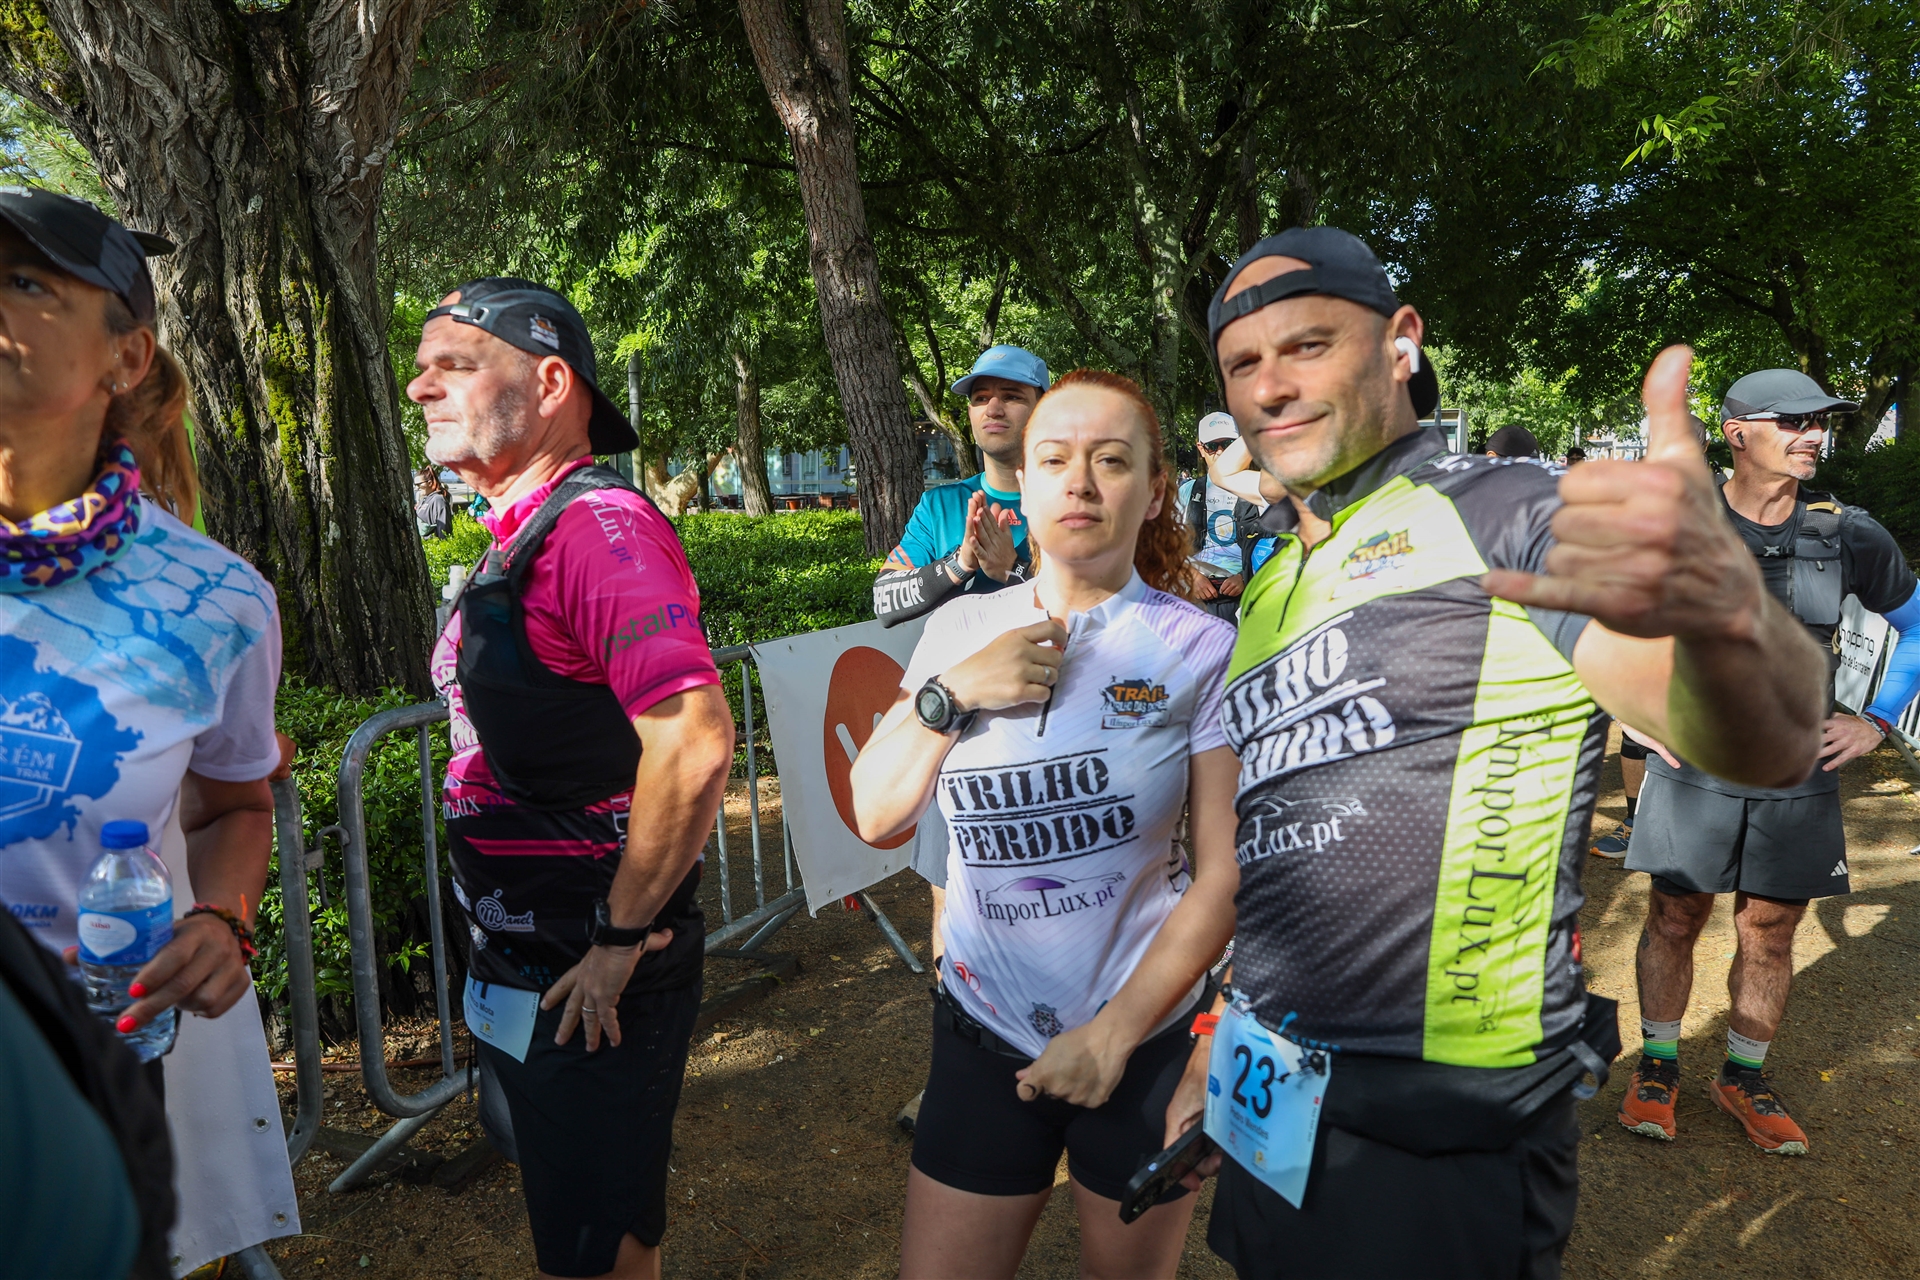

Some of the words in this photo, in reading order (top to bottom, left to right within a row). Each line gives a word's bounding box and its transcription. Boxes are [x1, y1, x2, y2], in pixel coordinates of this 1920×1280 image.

[1113, 686, 1169, 703] TRAIL
[941, 756, 1110, 811] TRILHO
[952, 804, 1136, 861] PERDIDO
[1445, 721, 1552, 1006] ImporLux.pt
[1232, 1044, 1276, 1119] 23
